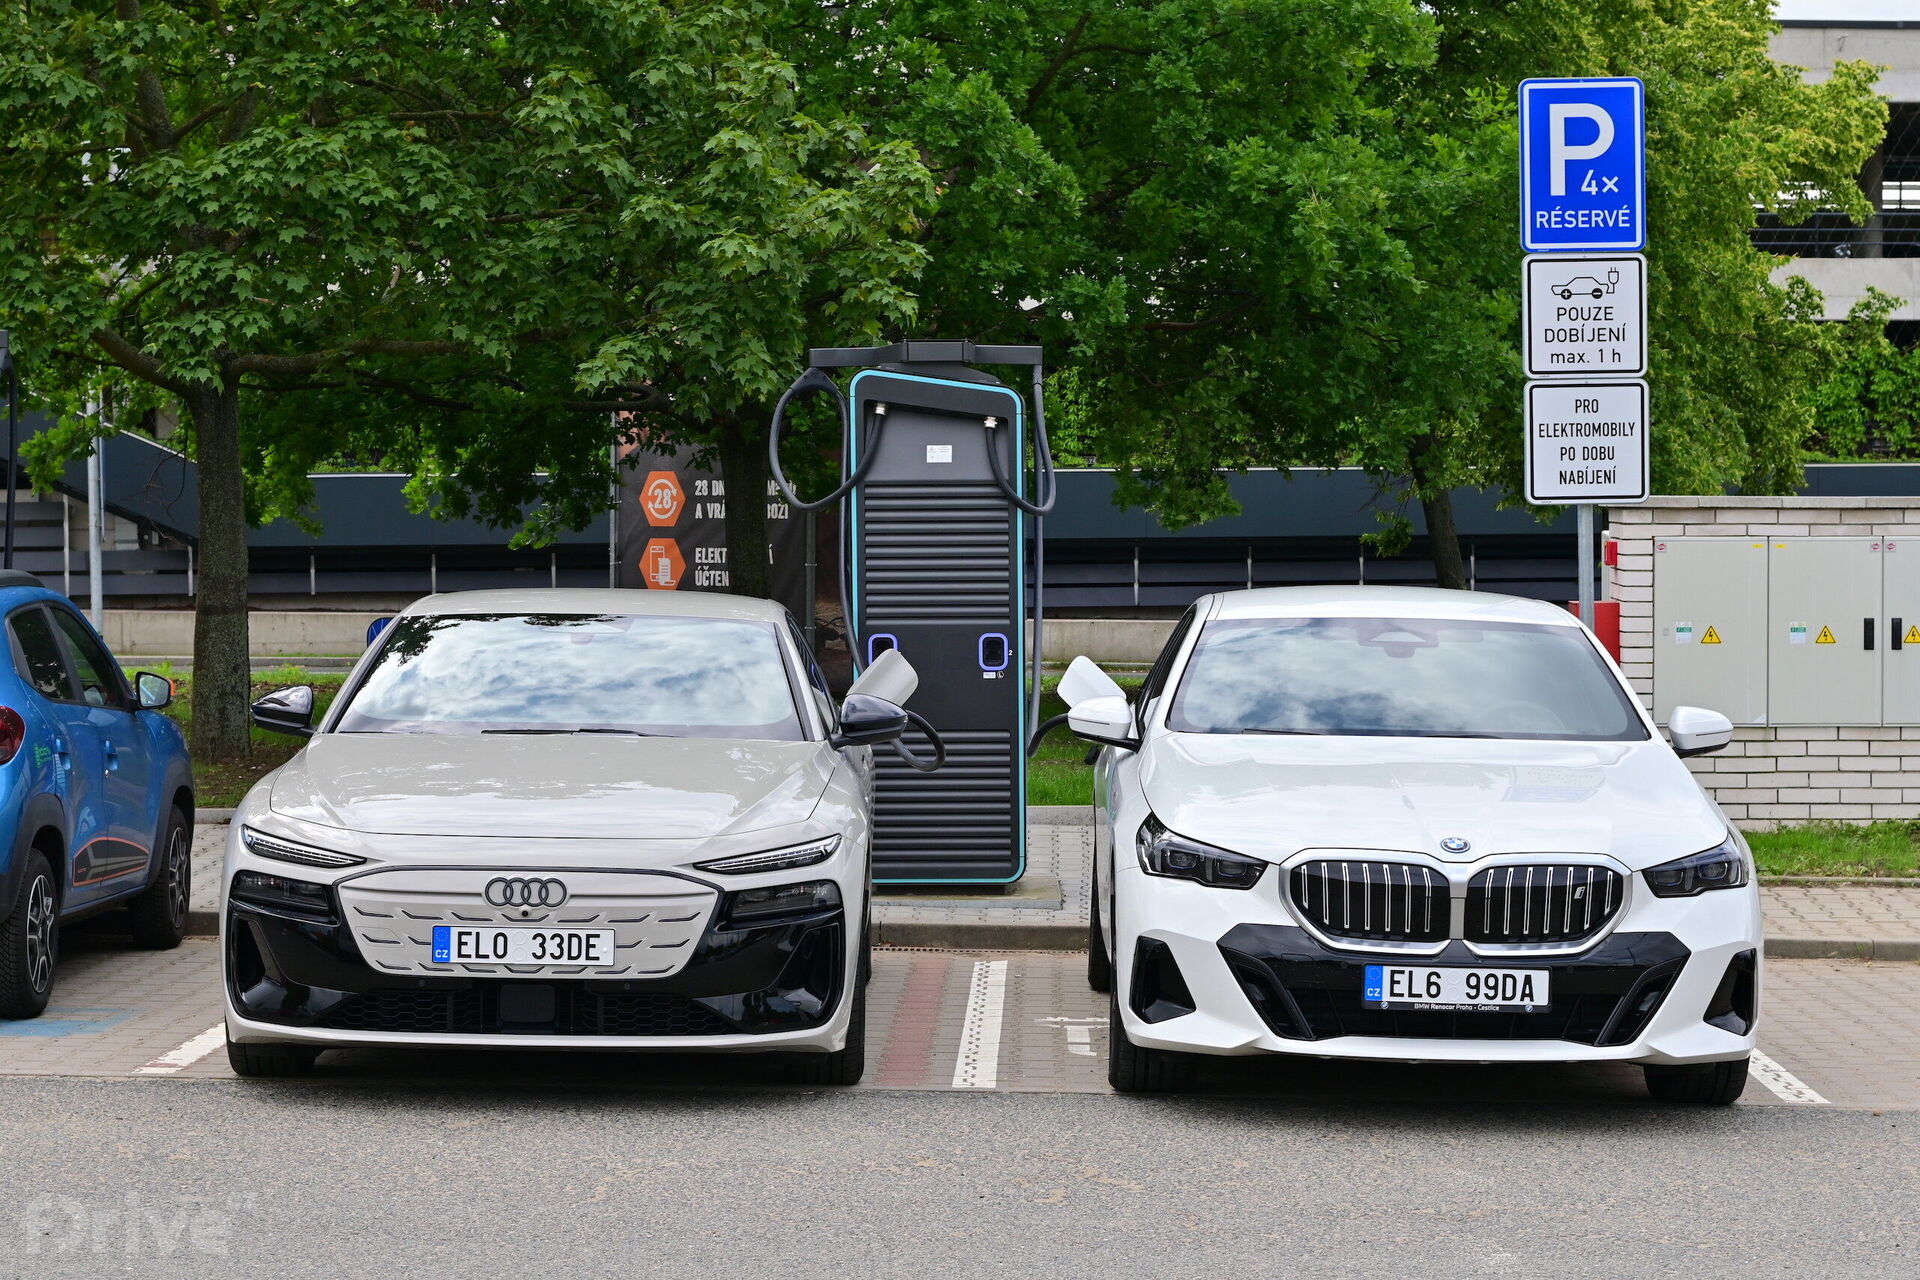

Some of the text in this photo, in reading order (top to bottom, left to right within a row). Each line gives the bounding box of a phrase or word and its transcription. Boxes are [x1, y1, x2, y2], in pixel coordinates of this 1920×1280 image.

[1549, 103, 1615, 196] P
[1536, 205, 1631, 228] RÉSERVÉ
[1556, 307, 1614, 322] POUZE
[1544, 323, 1626, 343] DOBÍJENÍ
[1550, 349, 1621, 364] max. 1 h
[1574, 399, 1599, 414] PRO
[1538, 422, 1636, 438] ELEKTROMOBILY
[1560, 446, 1615, 461] PO DOBU
[1559, 466, 1617, 485] NABÍJENÍ
[695, 480, 709, 496] 28
[654, 488, 672, 509] 28
[695, 503, 703, 519] A
[695, 547, 728, 564] ELEKT
[695, 565, 730, 587] ÚČTEN
[435, 950, 449, 958] CZ
[531, 932, 601, 961] 33DE
[1367, 988, 1381, 997] CZ
[1389, 970, 1535, 1002] EL6 99DA
